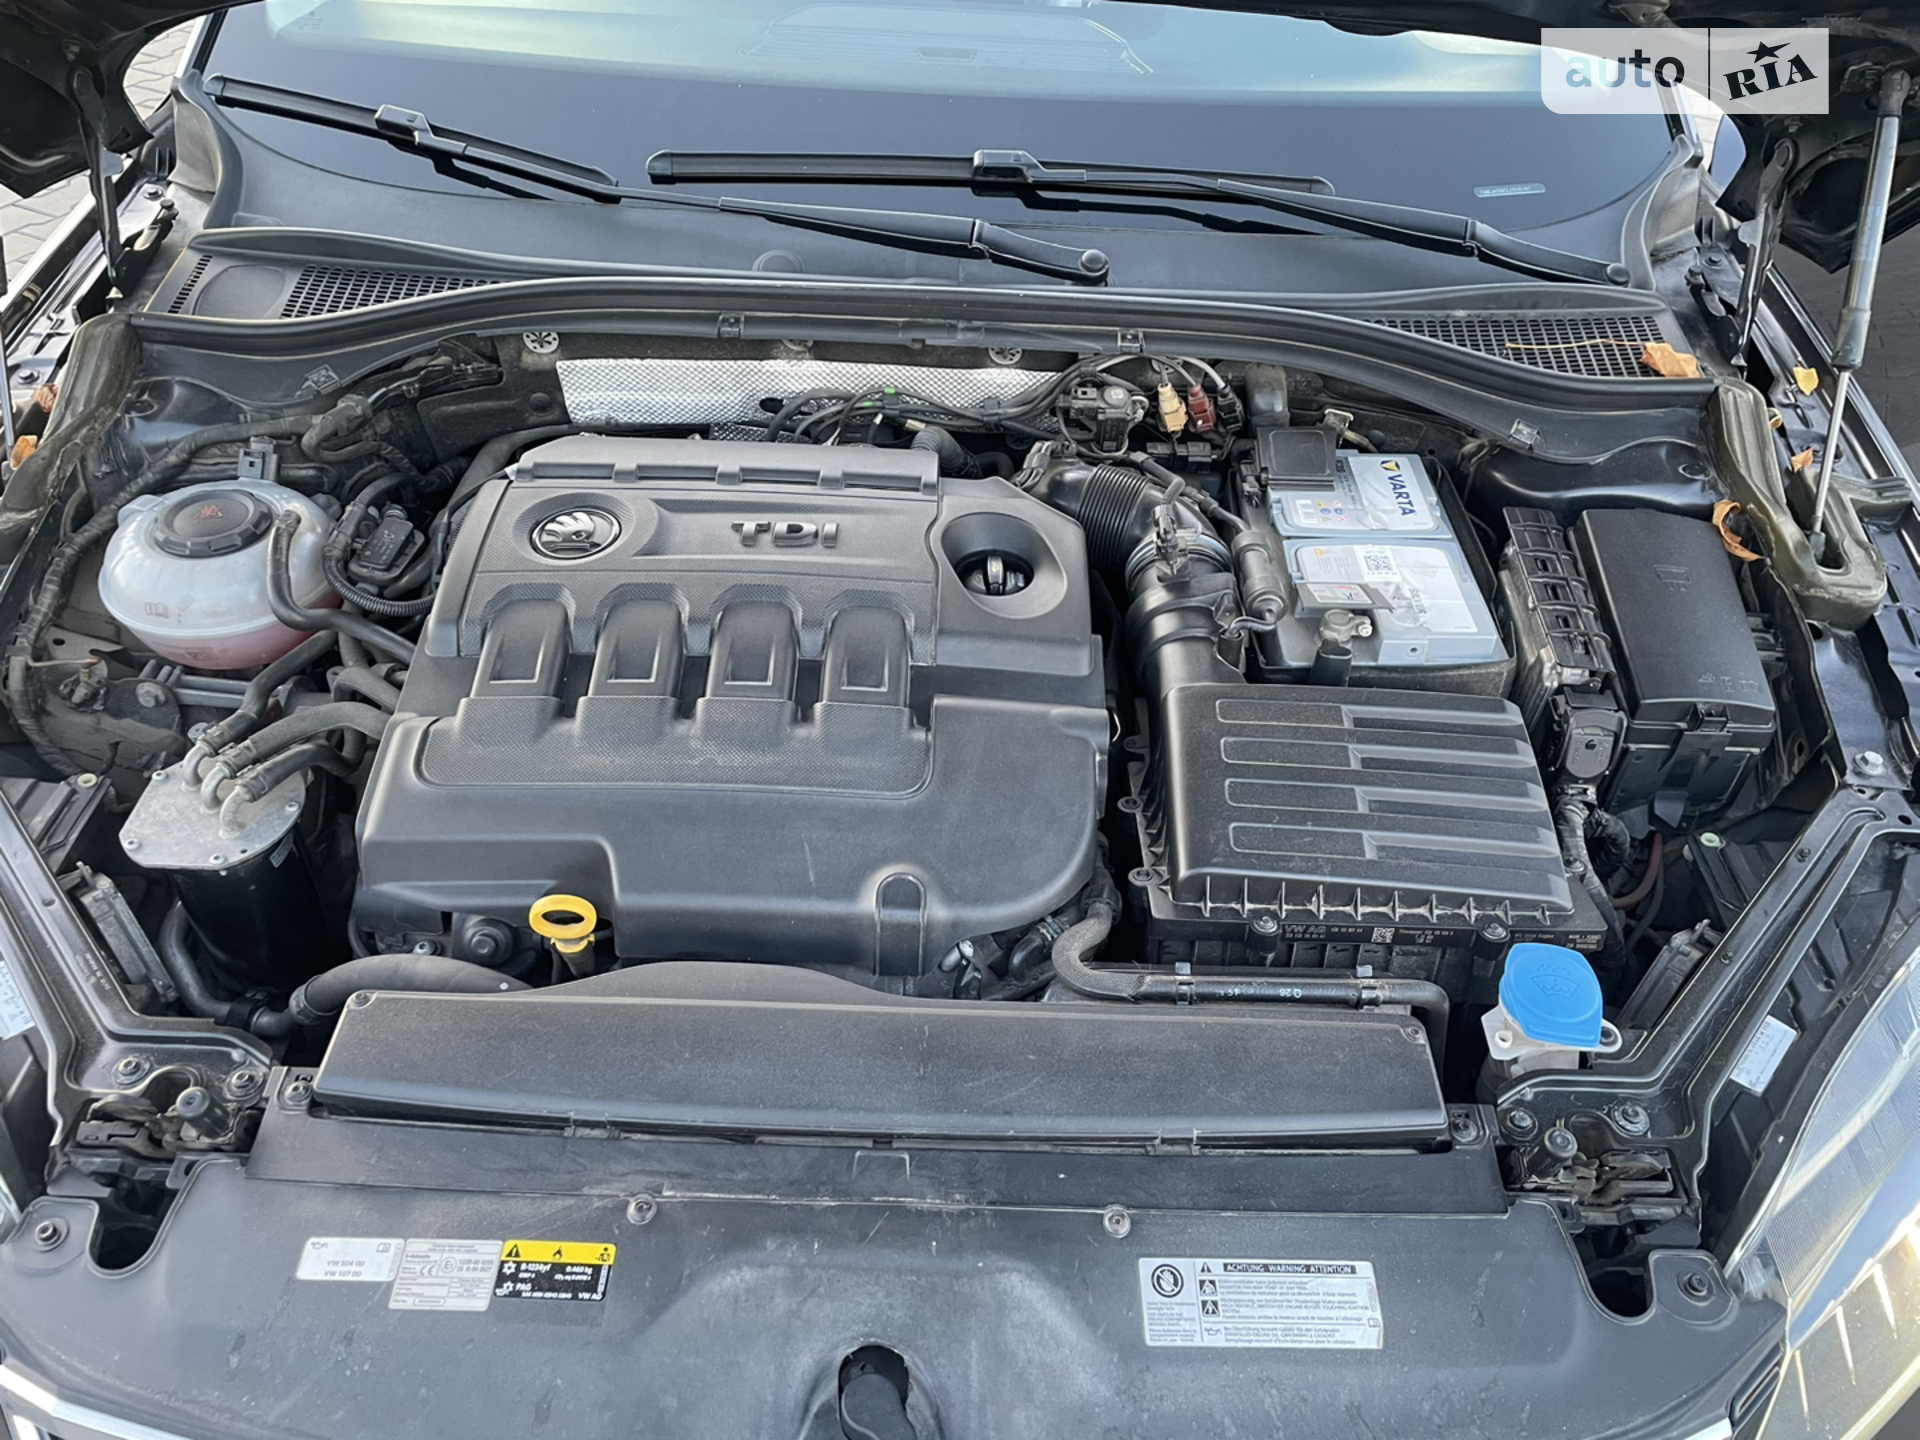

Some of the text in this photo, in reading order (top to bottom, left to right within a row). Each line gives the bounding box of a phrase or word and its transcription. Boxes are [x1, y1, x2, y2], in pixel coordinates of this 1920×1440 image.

[1387, 474, 1417, 516] VARTA
[731, 520, 840, 549] TDI
[1284, 925, 1306, 933] VW
[1307, 925, 1327, 934] AG
[327, 1259, 340, 1267] VW
[340, 1259, 354, 1267] 504
[1226, 1263, 1351, 1274] ACHTUNG WARNING ATTENTION
[515, 1283, 532, 1292] PAG
